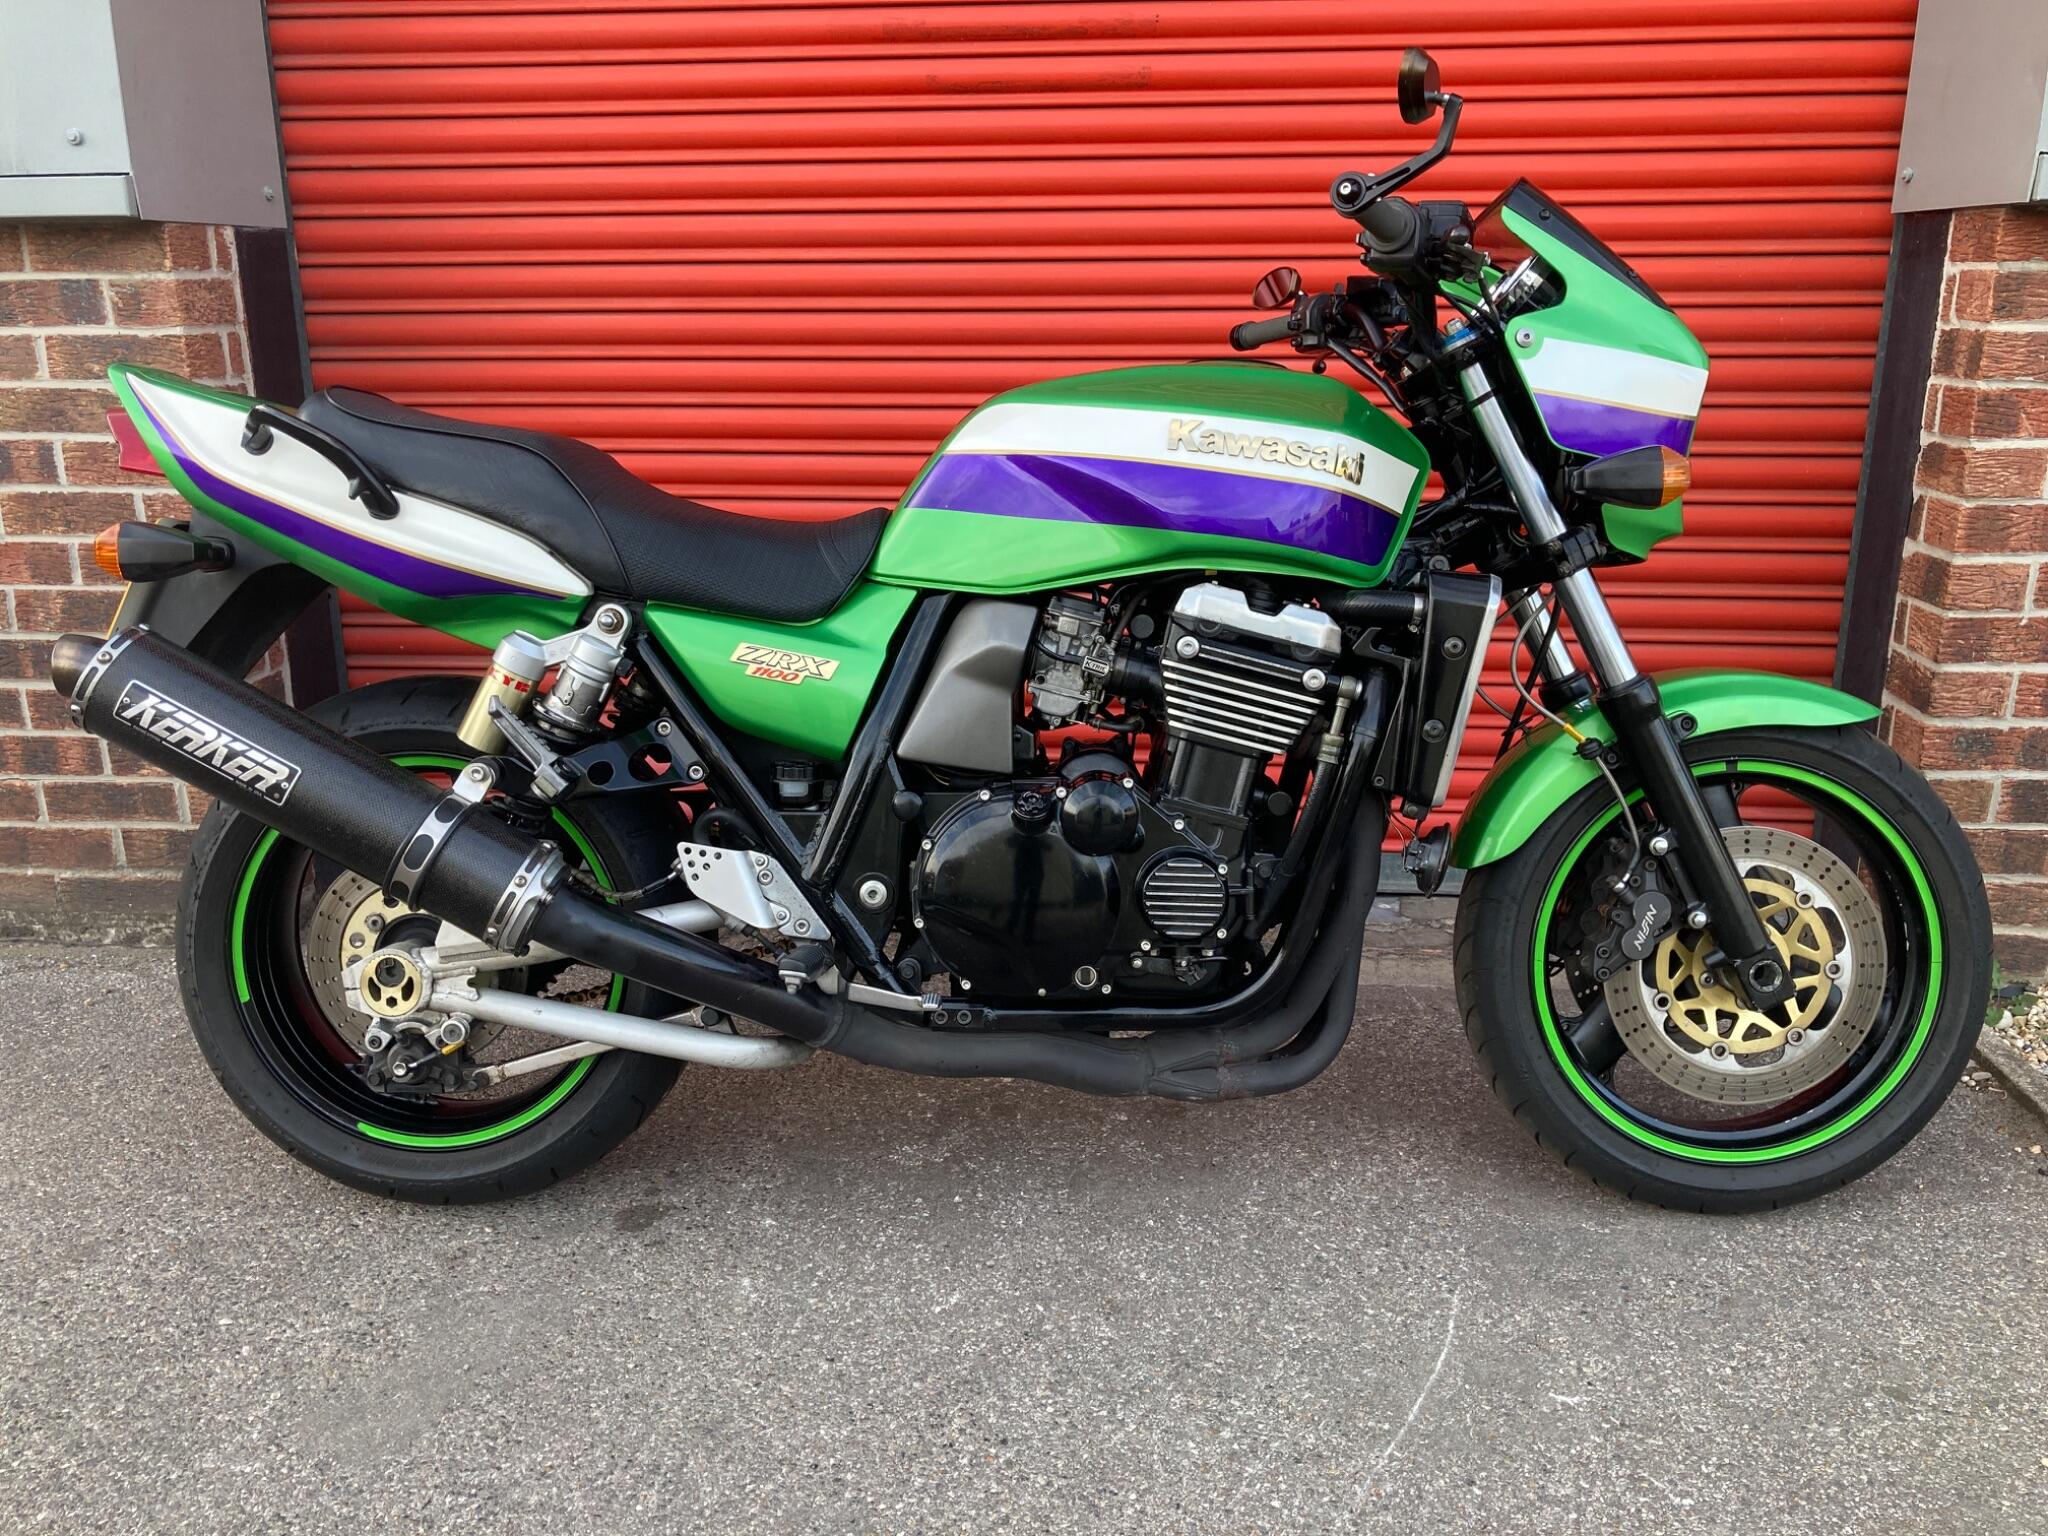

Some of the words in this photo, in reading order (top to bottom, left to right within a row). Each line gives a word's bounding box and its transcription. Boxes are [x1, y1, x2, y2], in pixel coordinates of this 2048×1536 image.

[1168, 418, 1365, 485] Kawasaki
[736, 645, 832, 677] ZRX
[751, 666, 800, 682] 1100
[120, 693, 290, 792] KERKER
